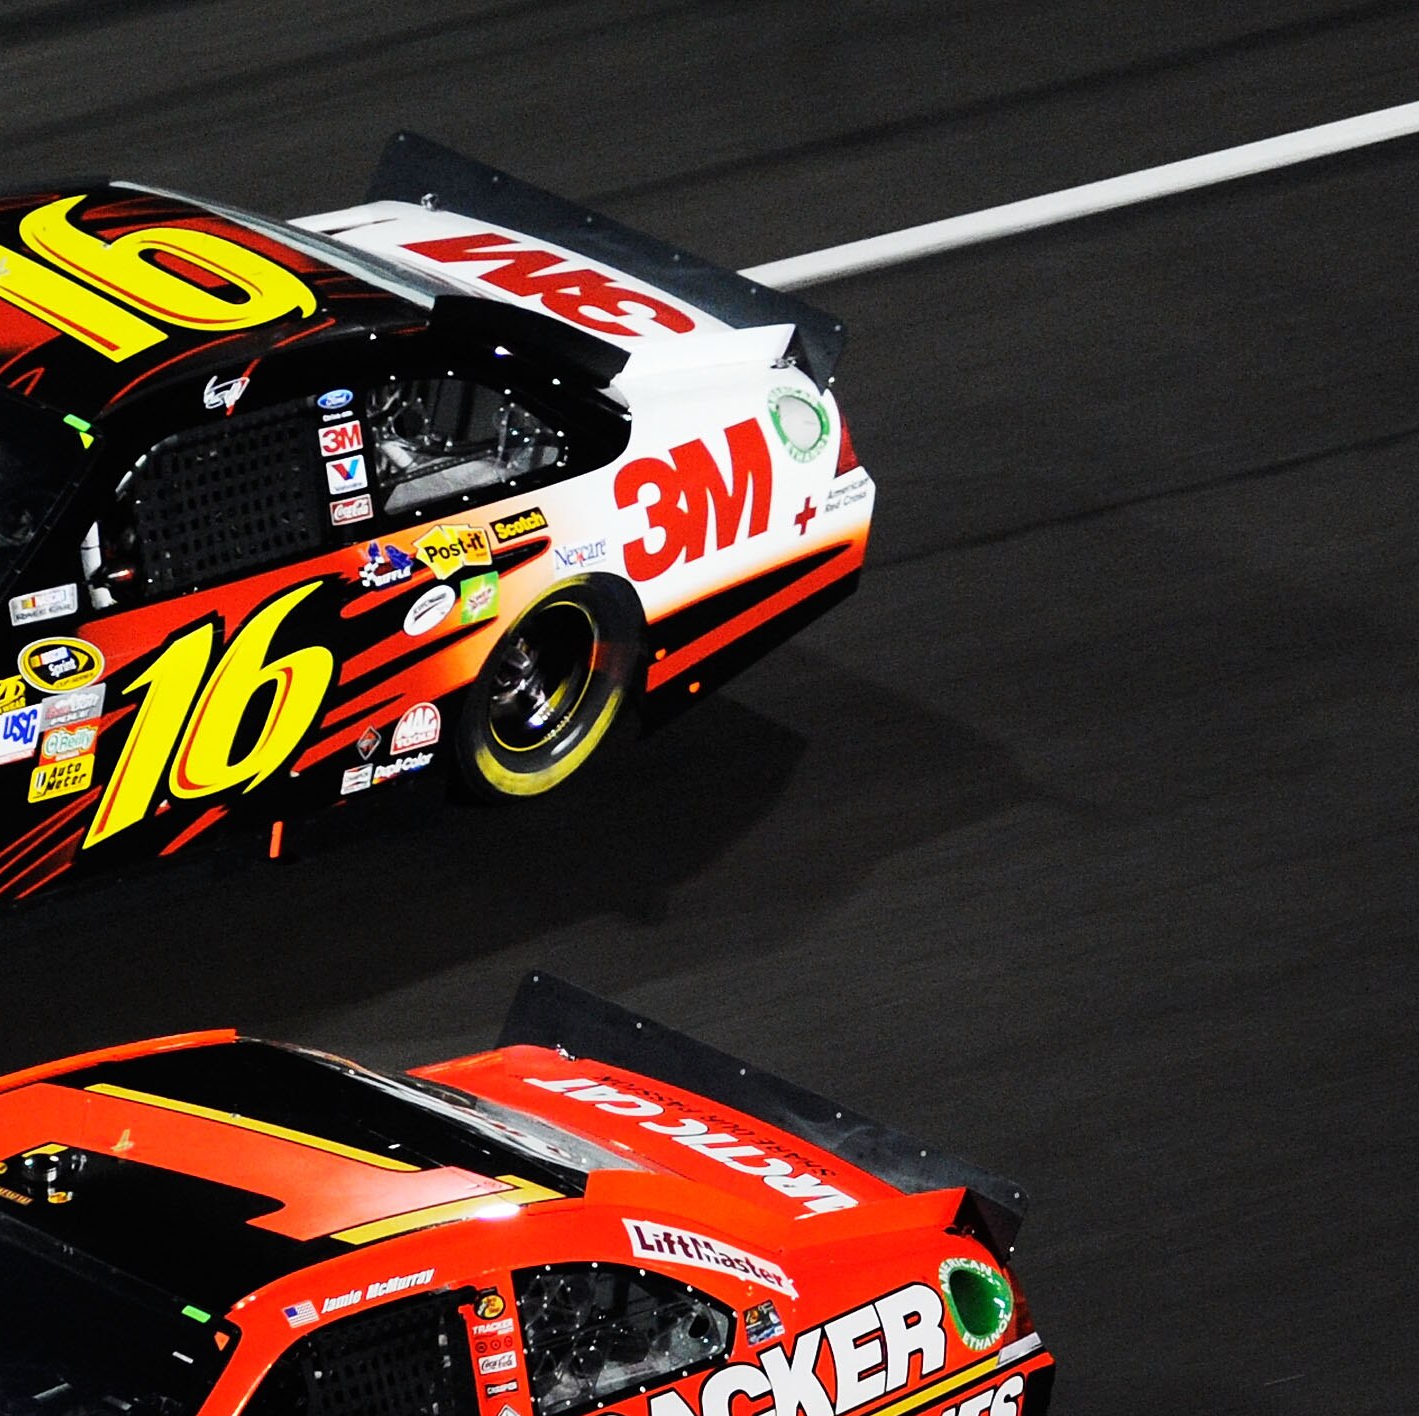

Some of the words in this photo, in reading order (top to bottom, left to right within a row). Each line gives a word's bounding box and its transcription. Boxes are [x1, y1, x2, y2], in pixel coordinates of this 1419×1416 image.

[401, 233, 695, 337] 3M
[323, 424, 361, 453] 3M
[614, 418, 772, 582] 3M
[495, 511, 546, 540] Scotch
[425, 532, 485, 563] Post-it
[554, 538, 607, 570] Nexcare
[3, 709, 38, 745] USG
[82, 580, 333, 850] 16
[52, 763, 82, 779] Auto
[524, 1077, 665, 1118] CAT
[639, 1119, 859, 1220] ARCTIC
[634, 1225, 789, 1287] LiftMaster
[321, 1289, 363, 1315] Jamie
[366, 1267, 436, 1300] McMurray
